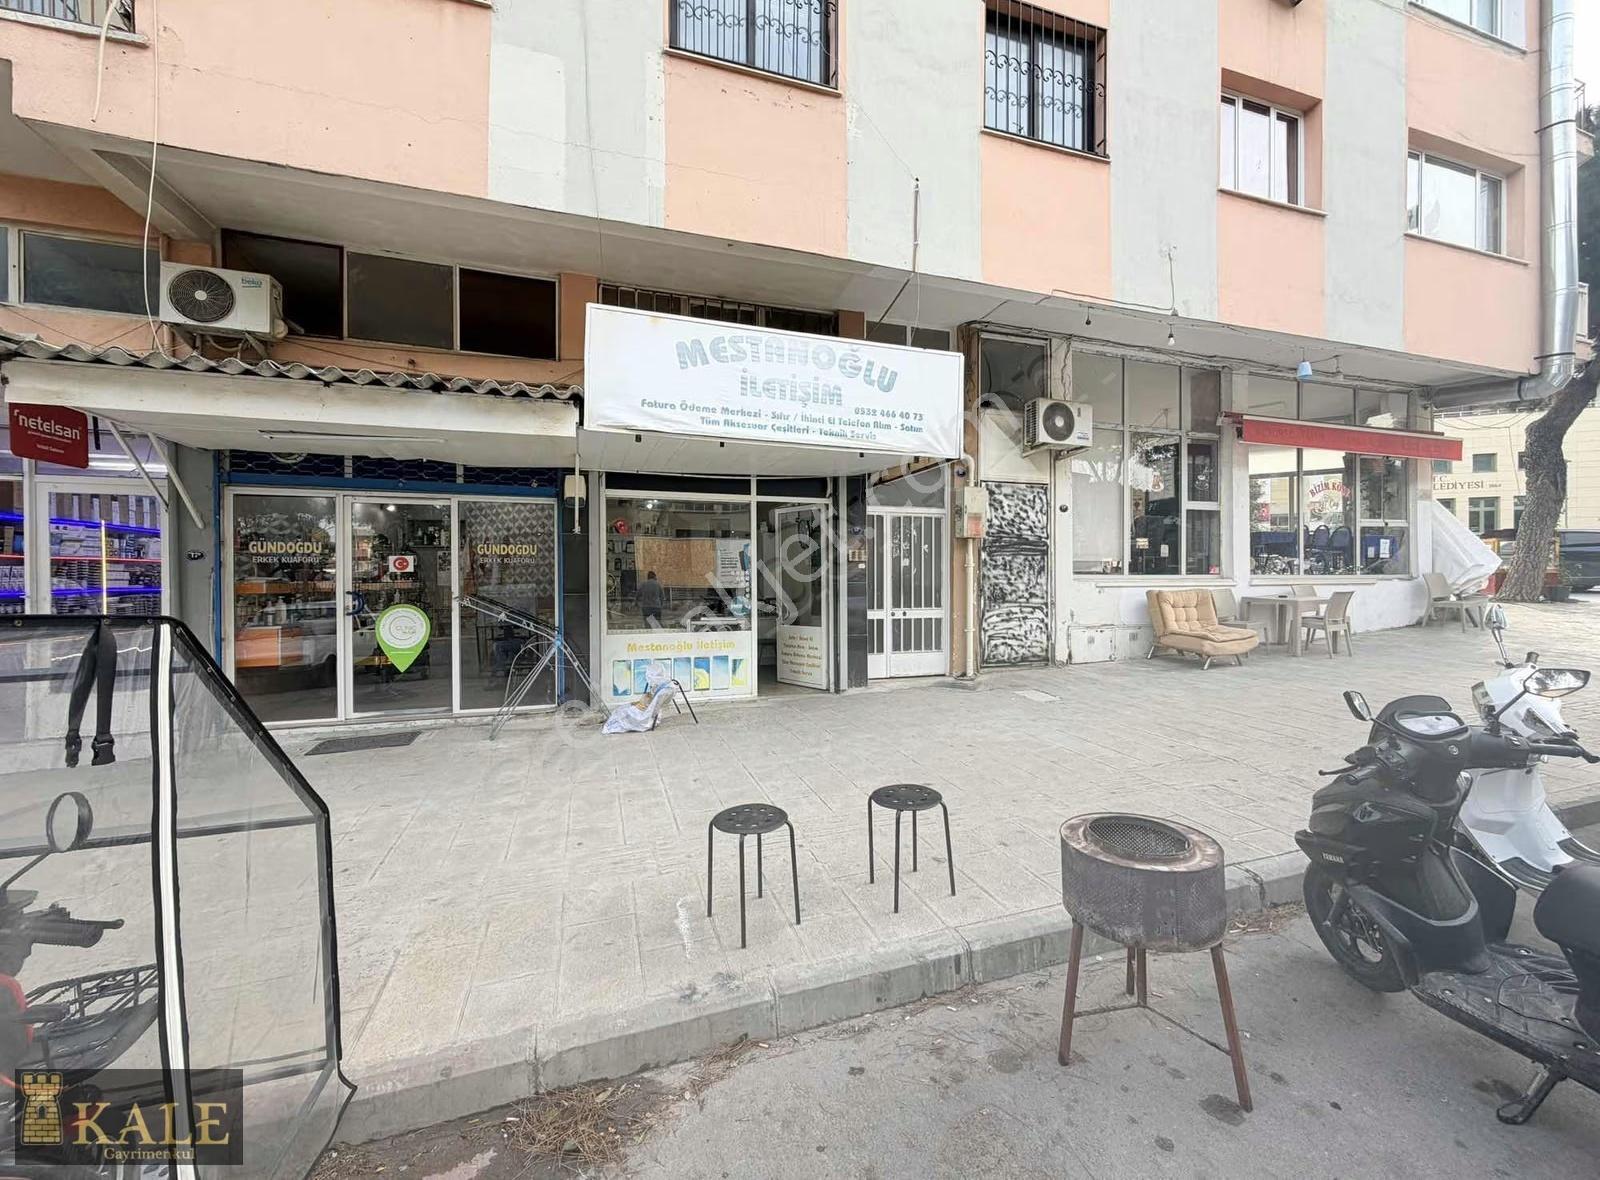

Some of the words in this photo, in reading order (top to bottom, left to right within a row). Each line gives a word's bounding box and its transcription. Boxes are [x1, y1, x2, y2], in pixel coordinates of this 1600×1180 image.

[675, 335, 898, 393] MESTANOĞLU
[740, 368, 843, 408] İLETİŞİM
[640, 398, 676, 411] Fatura
[680, 399, 717, 414] Ödeme
[720, 405, 761, 418] Merkezi
[827, 416, 836, 425] El
[838, 417, 871, 428] Telefon
[854, 407, 878, 417] 0532
[880, 409, 897, 418] 466
[899, 411, 910, 420] 40
[913, 412, 924, 421] 73
[18, 414, 81, 441] netelsan
[700, 416, 720, 427] Tüm
[723, 418, 768, 430] Aksesuar
[771, 422, 810, 435] Çeşitleri
[249, 538, 322, 554] GÜNDOĞDU
[477, 541, 537, 555] GÜNDOĞDU
[252, 556, 279, 564] ERKEK
[627, 641, 693, 653] Mestanoğlu
